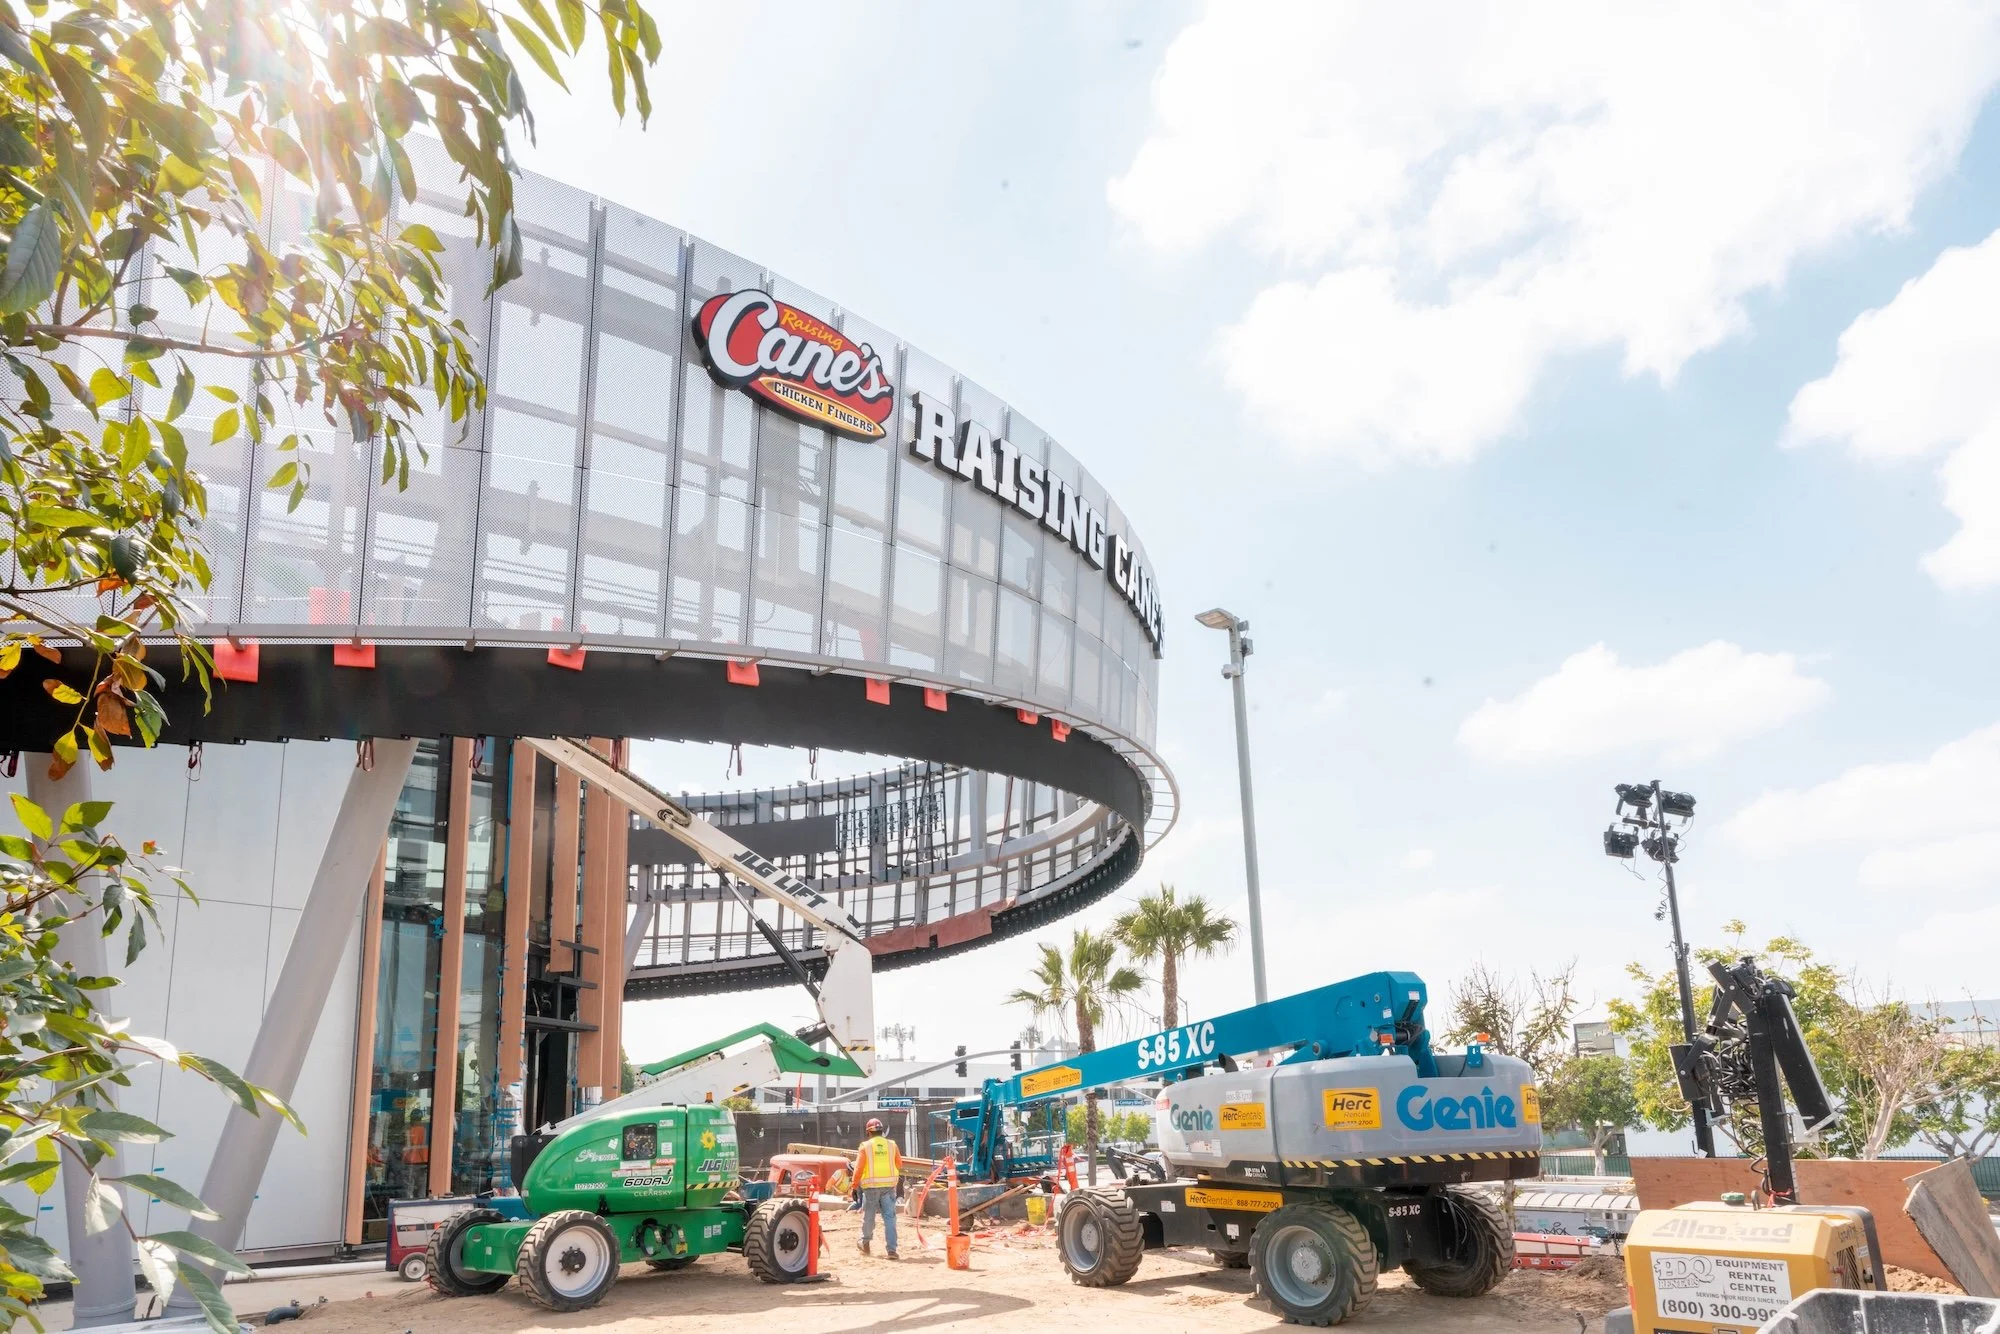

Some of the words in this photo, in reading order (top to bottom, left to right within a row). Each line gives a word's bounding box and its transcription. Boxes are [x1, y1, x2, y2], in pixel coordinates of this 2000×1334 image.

[780, 307, 844, 351] Raising
[708, 288, 892, 399] Cane's
[774, 382, 823, 412] CHICKEN
[909, 391, 1105, 570] RAISING
[733, 850, 778, 879] JLG
[773, 875, 829, 909] LIFT
[1137, 1030, 1180, 1070] S-85
[1185, 1021, 1215, 1059] XC
[1332, 1098, 1371, 1110] Herc
[1396, 1085, 1517, 1131] Genie
[1170, 1104, 1213, 1131] Genie
[696, 1159, 722, 1173] JLG
[623, 1176, 674, 1187] 600AJ
[1236, 1199, 1279, 1209] 888-777-2700
[1389, 1206, 1407, 1217] S-85
[1409, 1205, 1420, 1215] XC
[1652, 1218, 1793, 1242] Allmand
[1715, 1259, 1784, 1271] EQUIPMENT
[1729, 1271, 1775, 1282] RENTAL
[1730, 1283, 1777, 1294] CENTER
[1662, 1299, 1704, 1318] (800)
